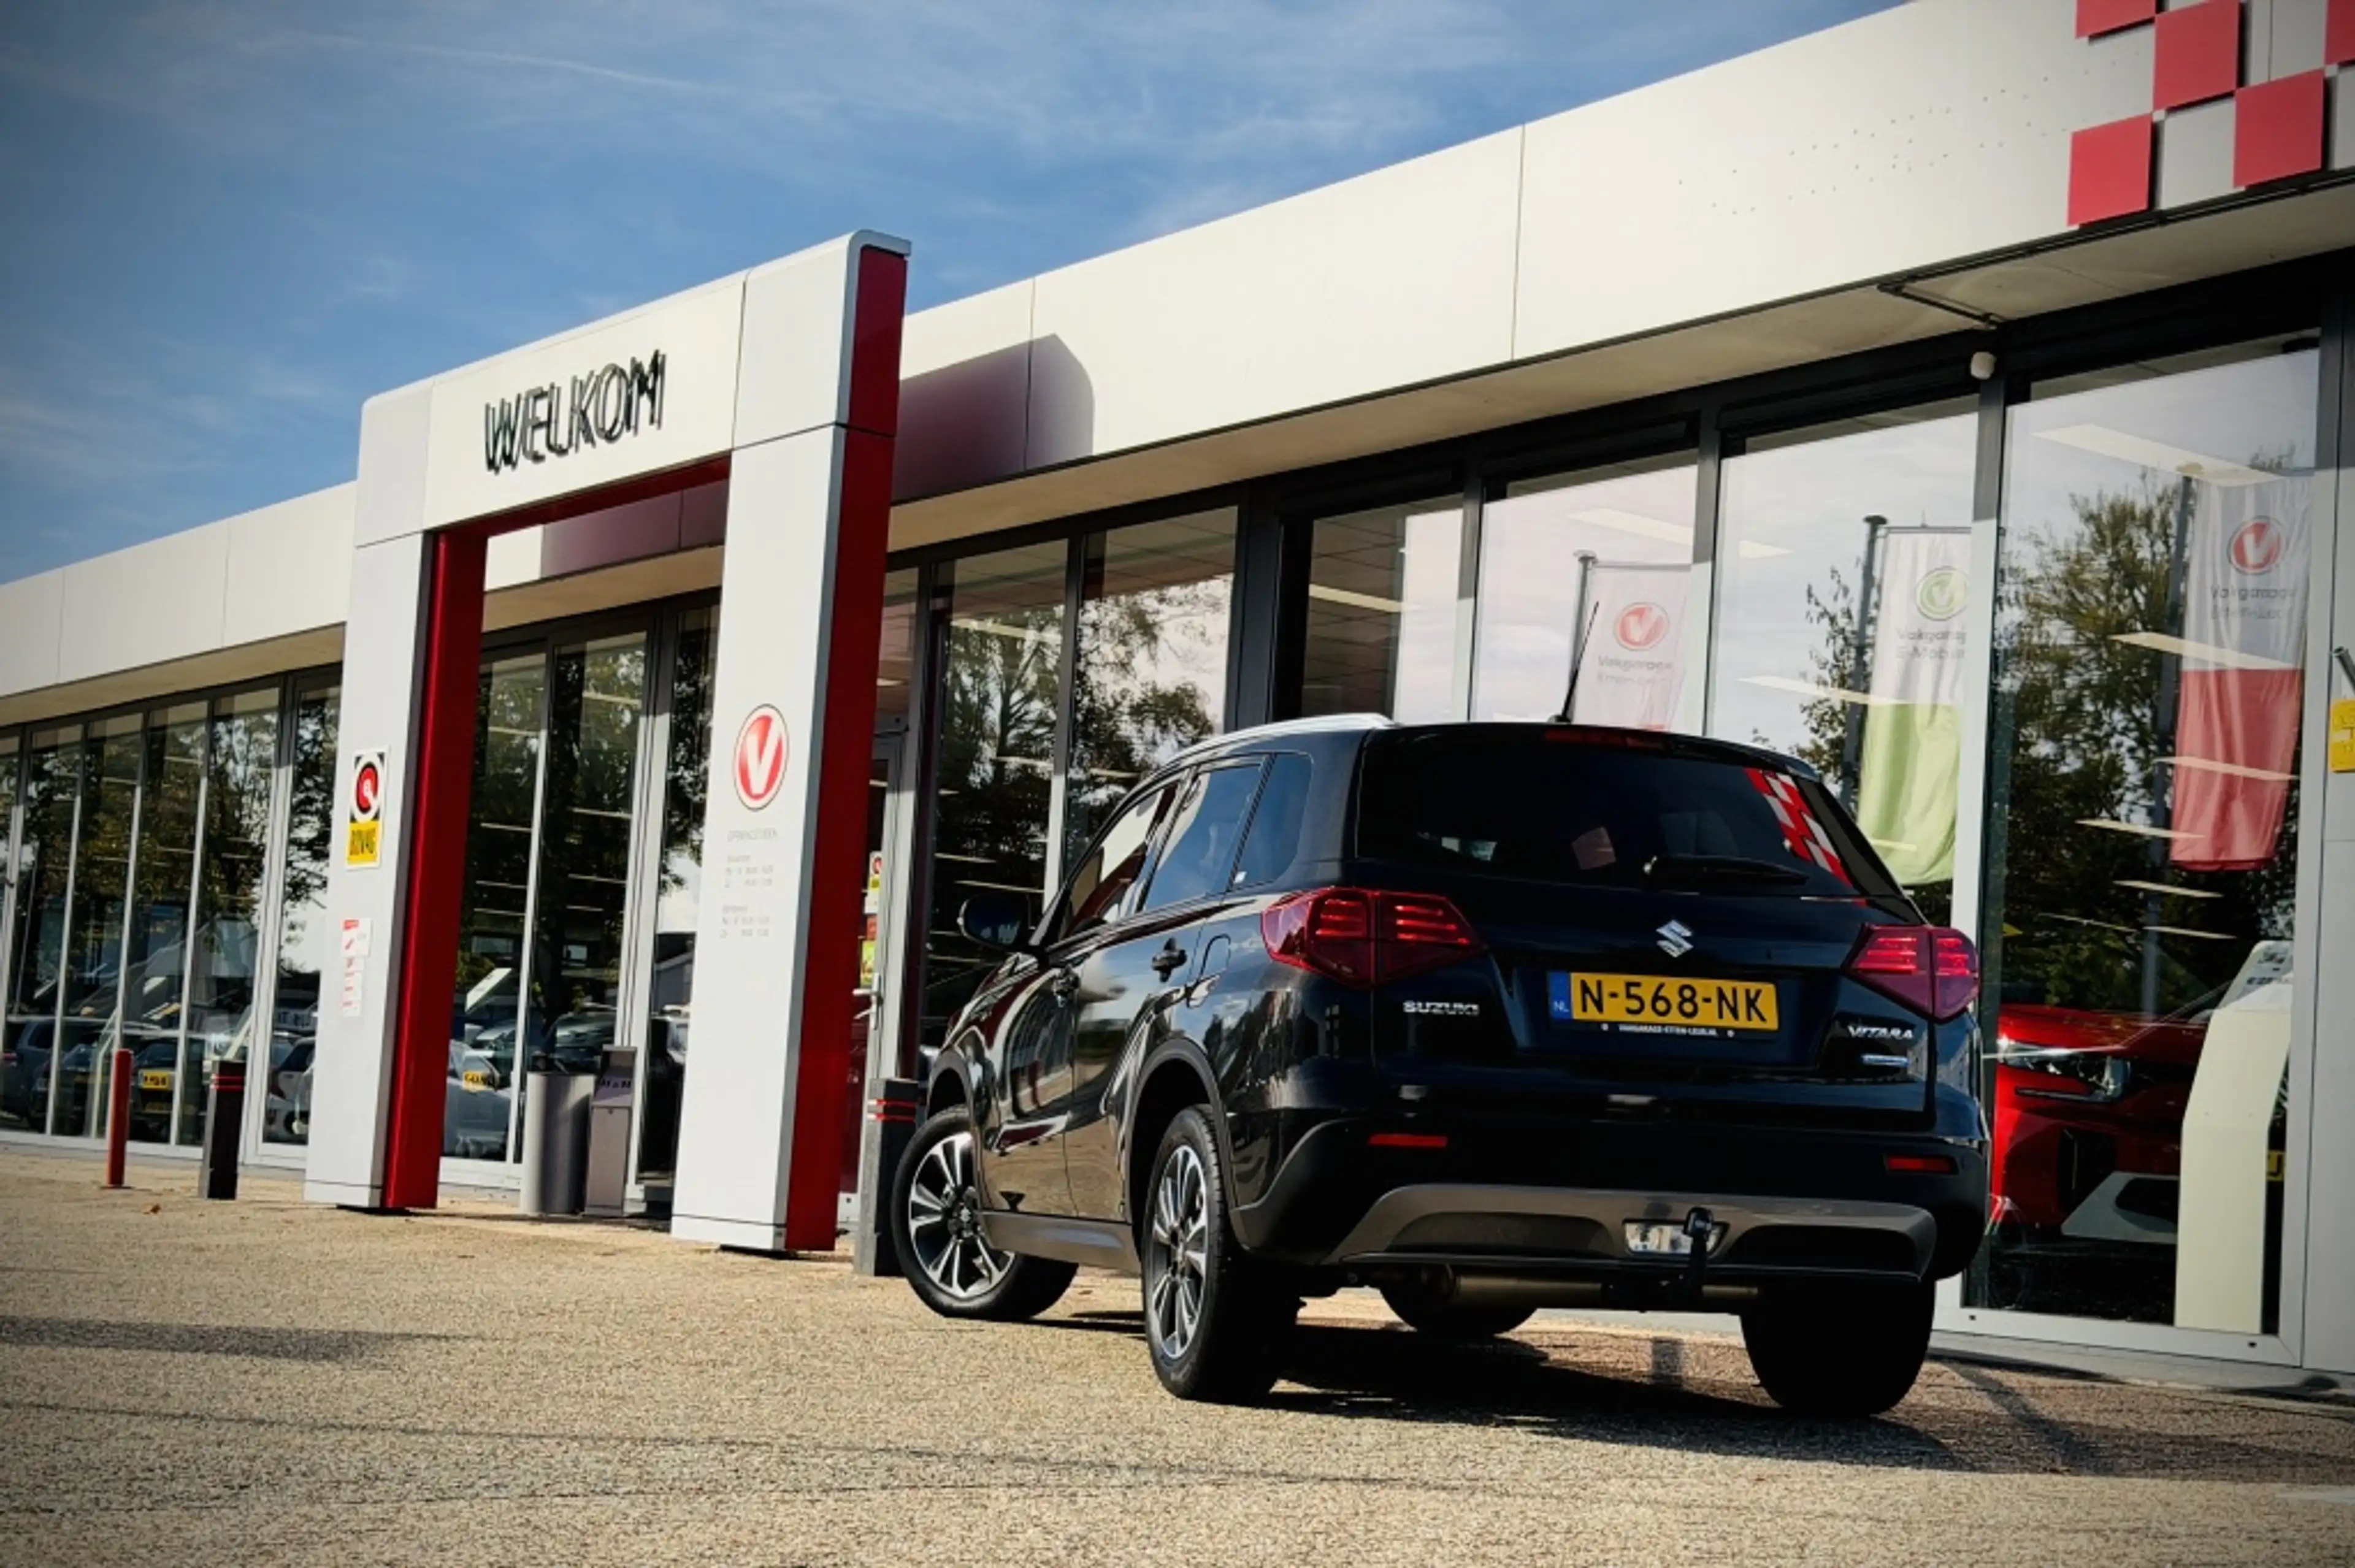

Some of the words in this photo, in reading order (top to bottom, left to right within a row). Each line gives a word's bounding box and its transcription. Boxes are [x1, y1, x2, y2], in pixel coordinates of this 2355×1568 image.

[484, 349, 667, 475] WELKOM
[1403, 1000, 1479, 1016] SUZUKI
[1553, 1001, 1570, 1012] NL
[1580, 979, 1767, 1023] N-568-NK
[1847, 1025, 1913, 1040] VITARA
